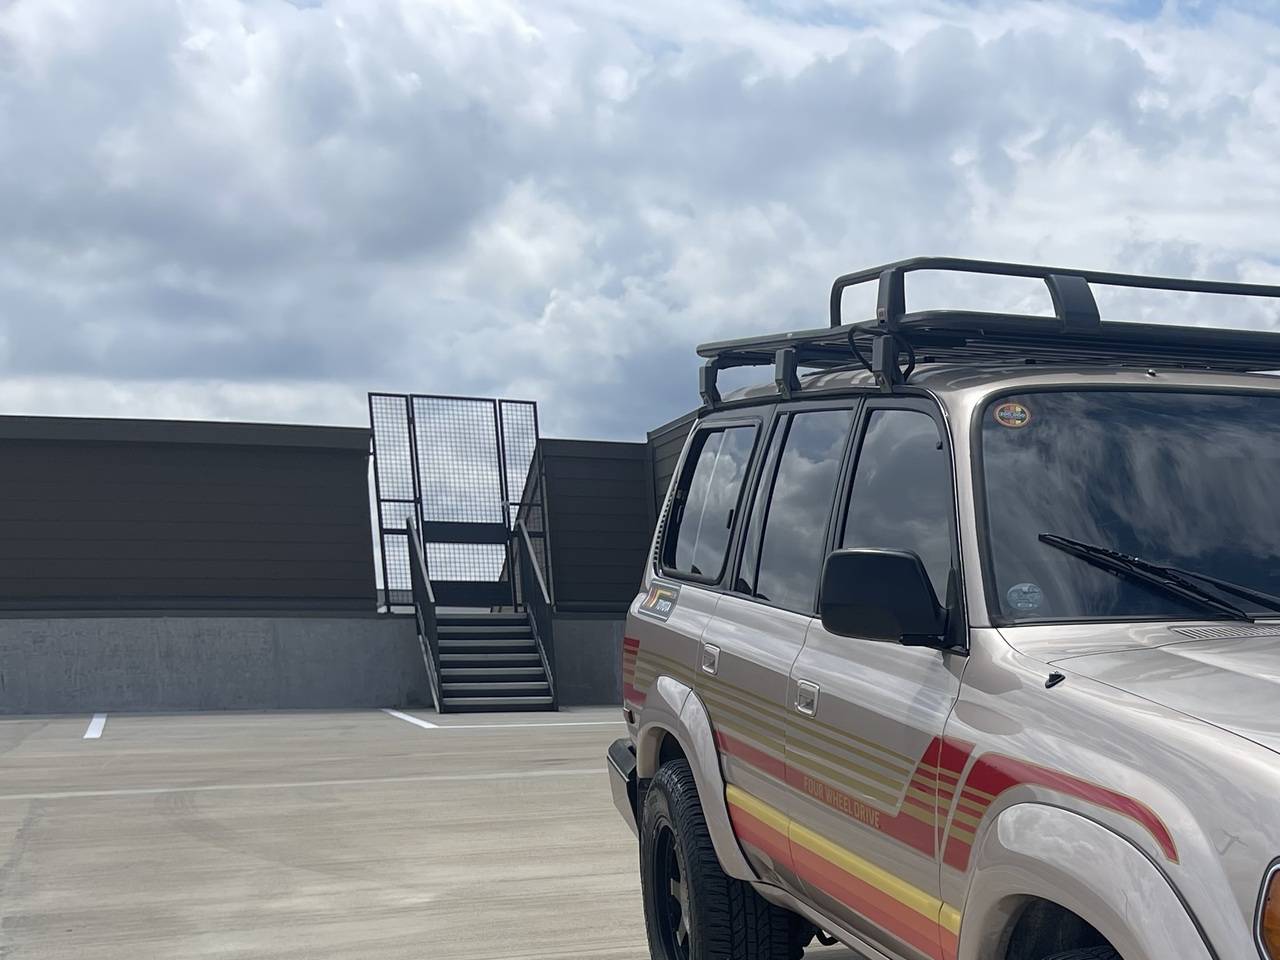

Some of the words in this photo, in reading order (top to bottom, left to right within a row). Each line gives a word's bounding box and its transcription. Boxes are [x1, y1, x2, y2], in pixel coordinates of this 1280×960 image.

[803, 776, 824, 801] FOUR
[824, 785, 853, 816] WHEEL
[853, 801, 881, 829] DRIVE
